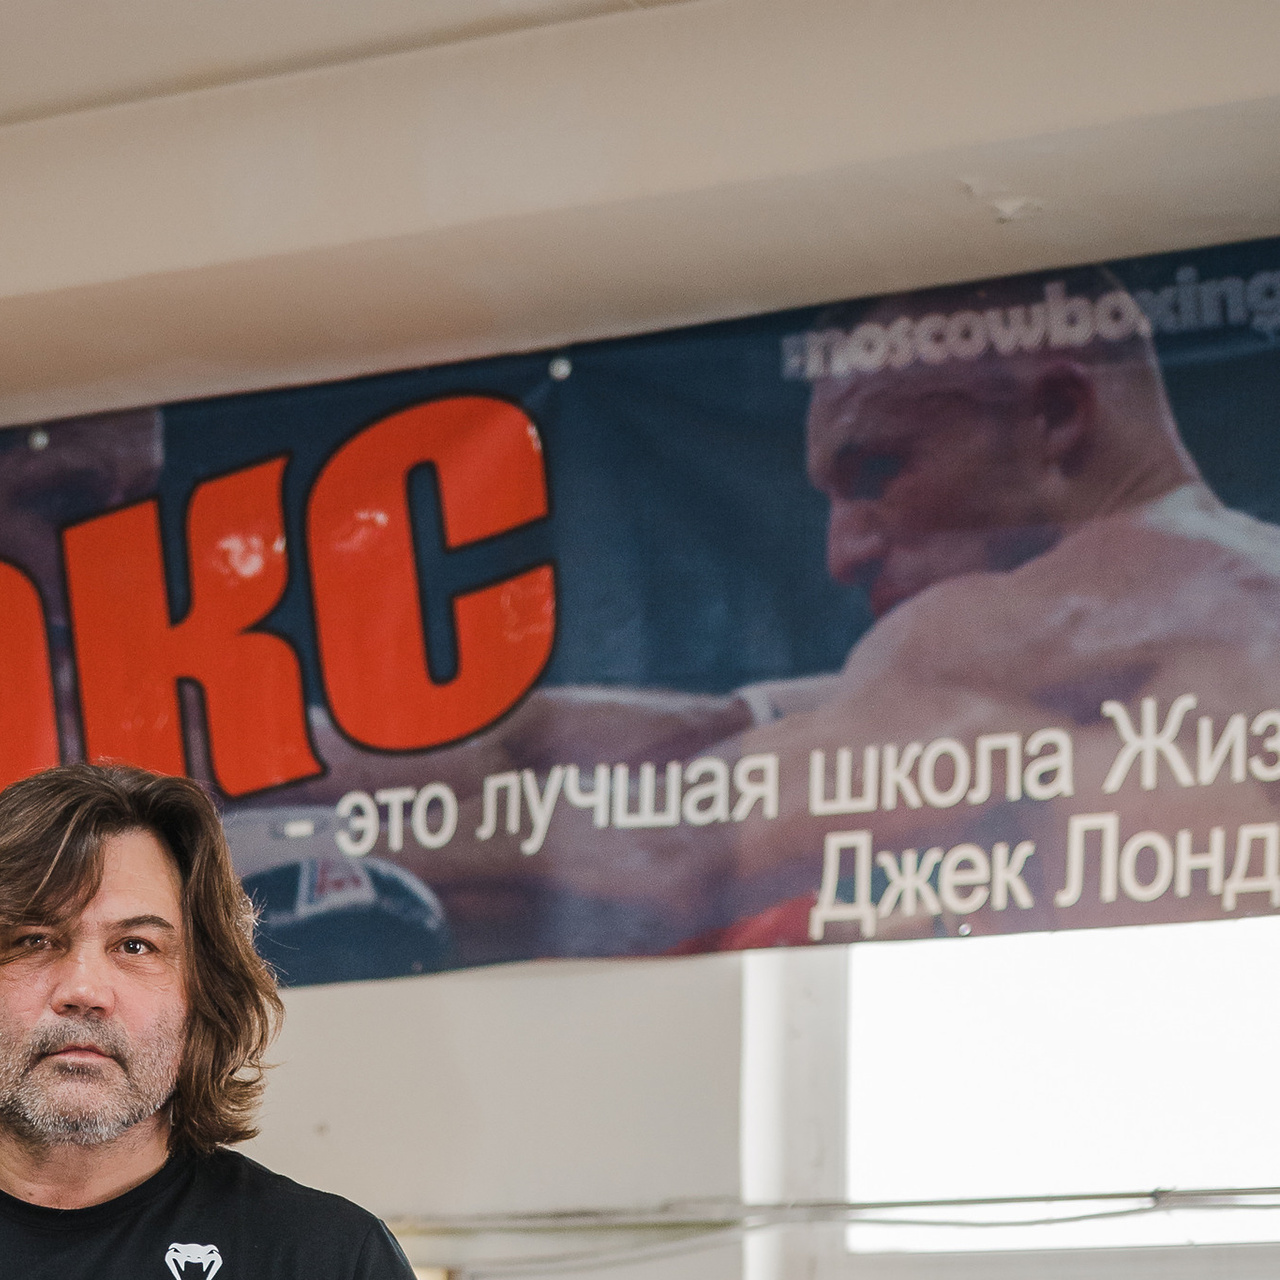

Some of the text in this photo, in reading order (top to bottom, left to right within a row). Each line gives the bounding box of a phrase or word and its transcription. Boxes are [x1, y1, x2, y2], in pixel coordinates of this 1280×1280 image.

[335, 782, 458, 856] это
[475, 753, 779, 855] лучшая
[810, 728, 1074, 815] школа
[1101, 694, 1280, 794] Жиз
[809, 812, 1280, 941] Джек Лонд
